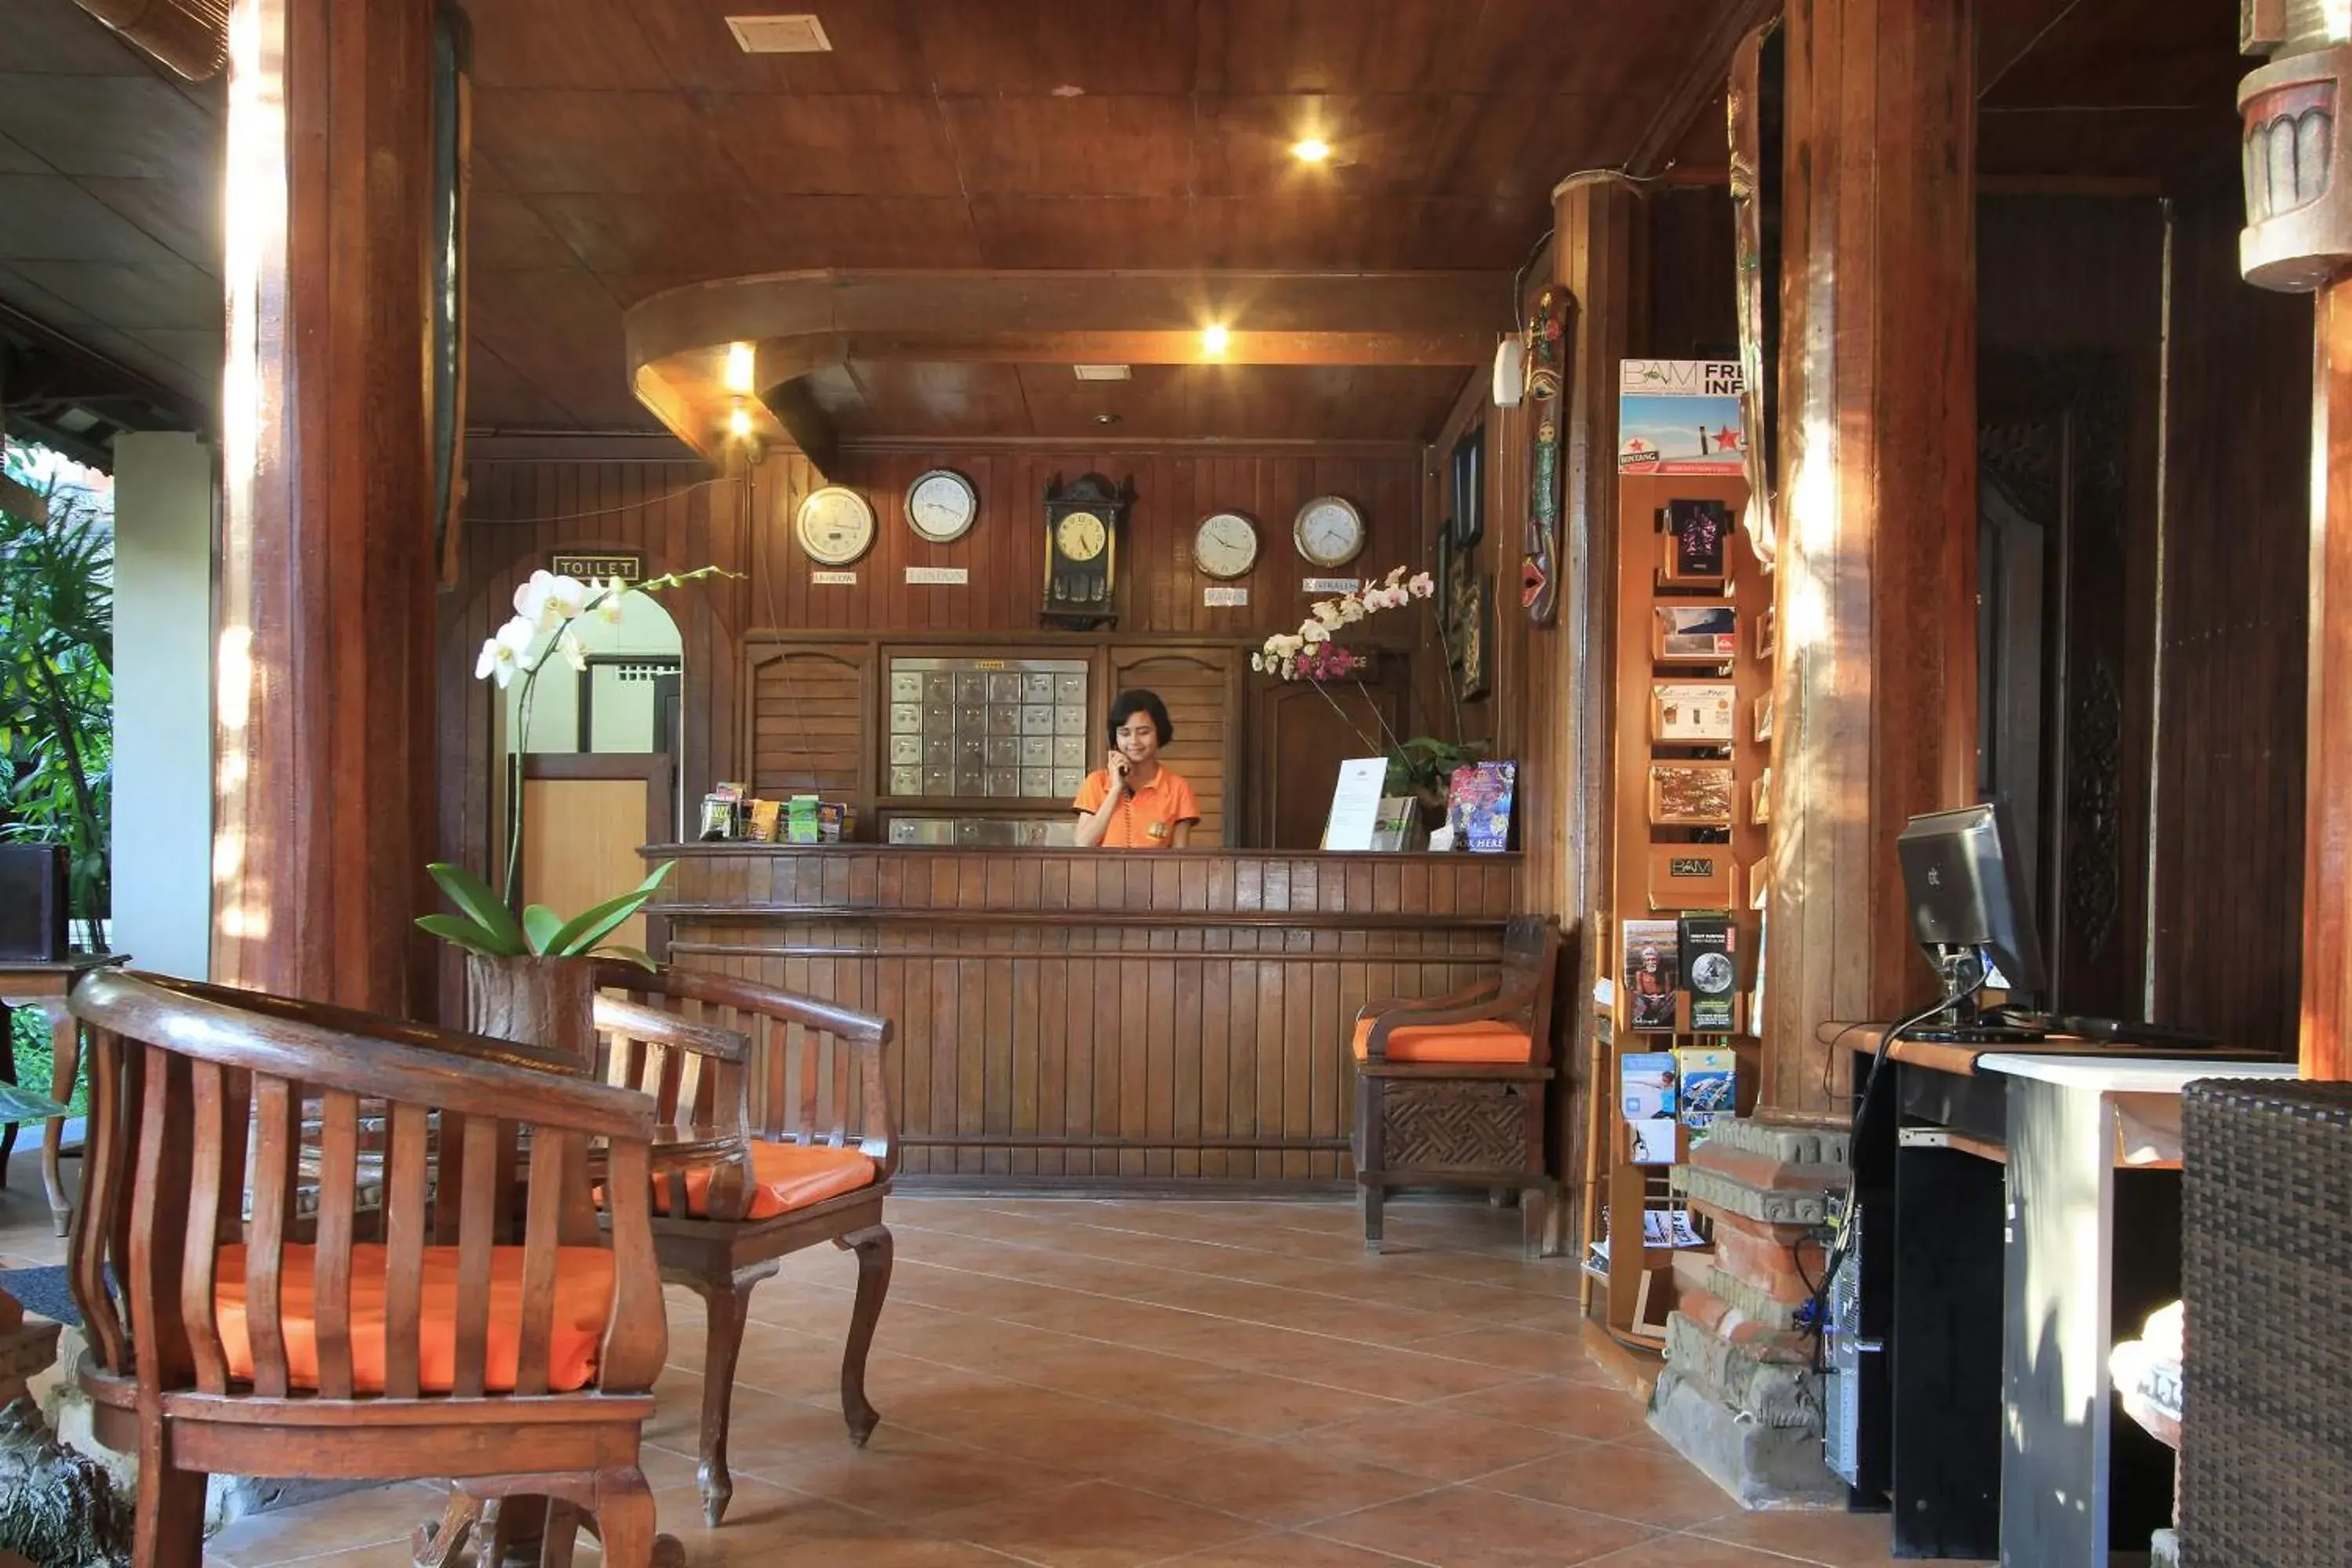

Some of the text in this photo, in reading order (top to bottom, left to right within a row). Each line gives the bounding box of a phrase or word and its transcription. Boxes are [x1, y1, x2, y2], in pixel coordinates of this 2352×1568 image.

[1623, 361, 1697, 386] BAM
[1704, 364, 1744, 378] FRE
[1704, 380, 1744, 394] INF
[561, 562, 632, 575] TOILET
